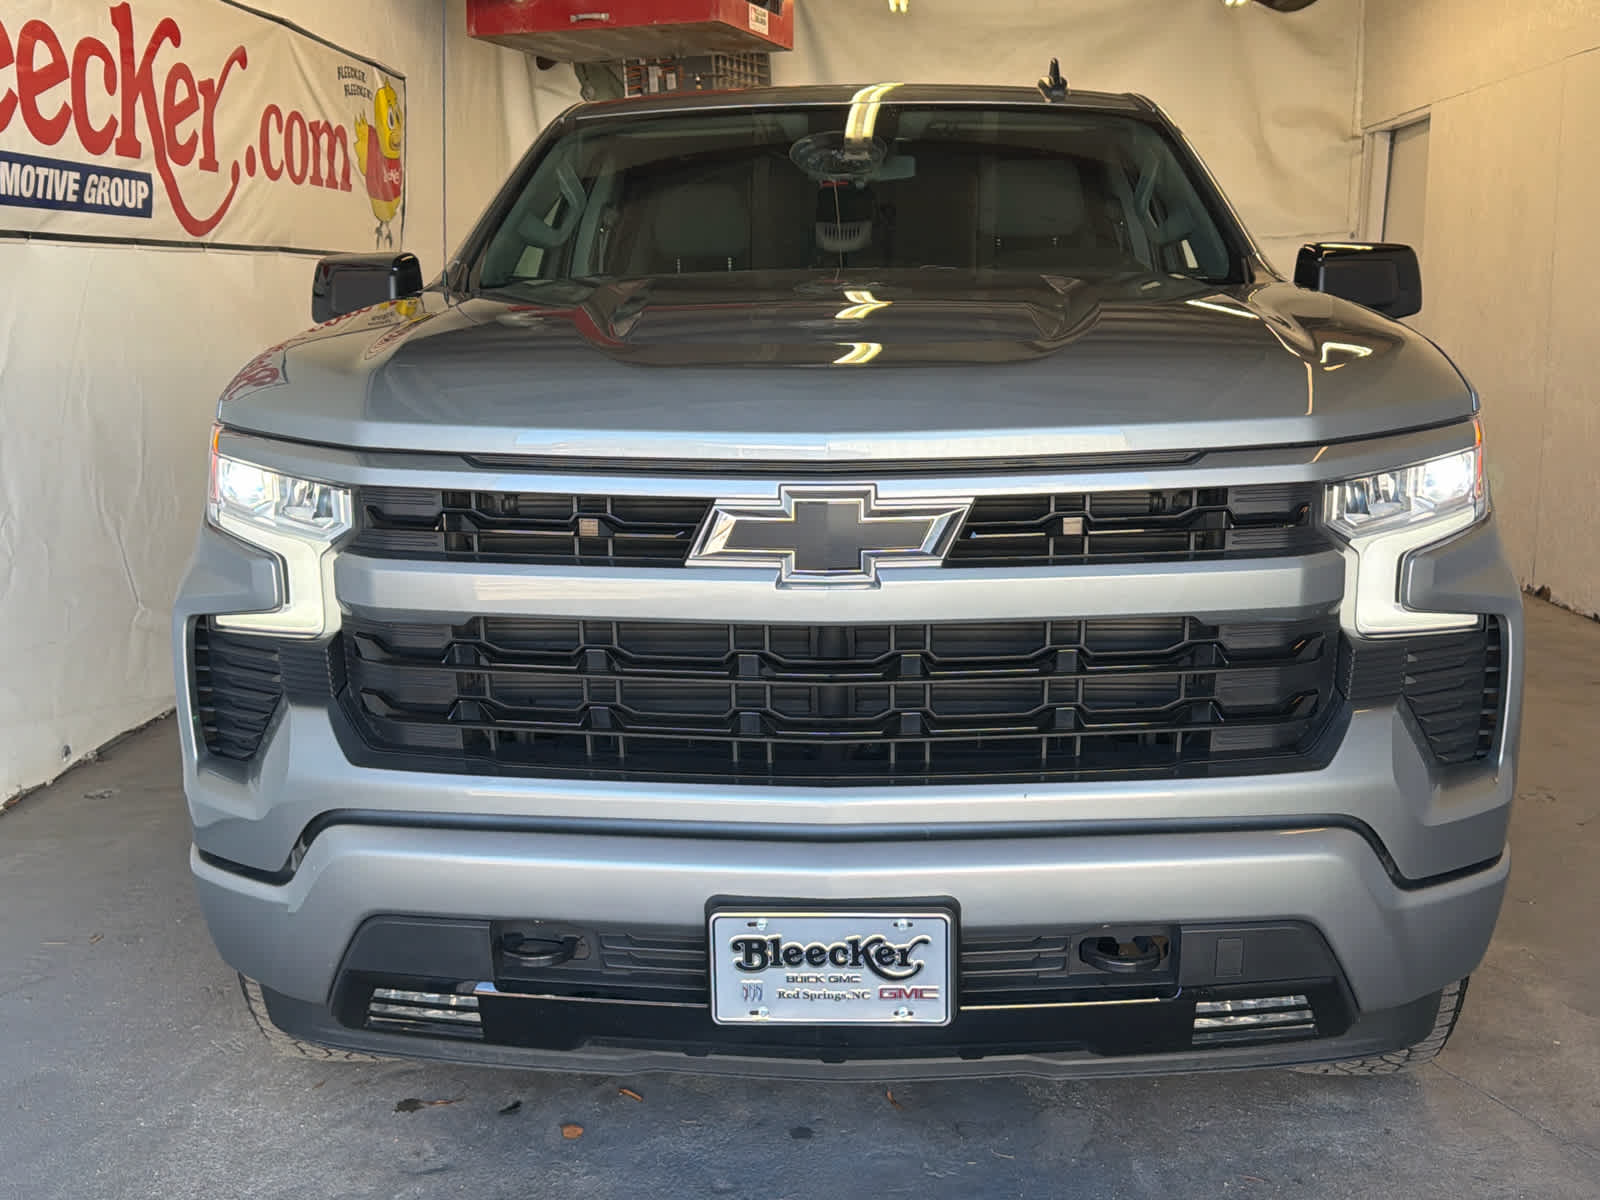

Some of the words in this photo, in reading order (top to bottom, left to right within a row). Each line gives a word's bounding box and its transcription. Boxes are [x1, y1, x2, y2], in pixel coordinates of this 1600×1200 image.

[0, 161, 81, 203] MOTIVE
[83, 174, 149, 209] GROUP
[785, 974, 825, 984] BUICK
[828, 974, 862, 984] GMC
[777, 988, 800, 1000] Red
[878, 985, 940, 1000] GMC
